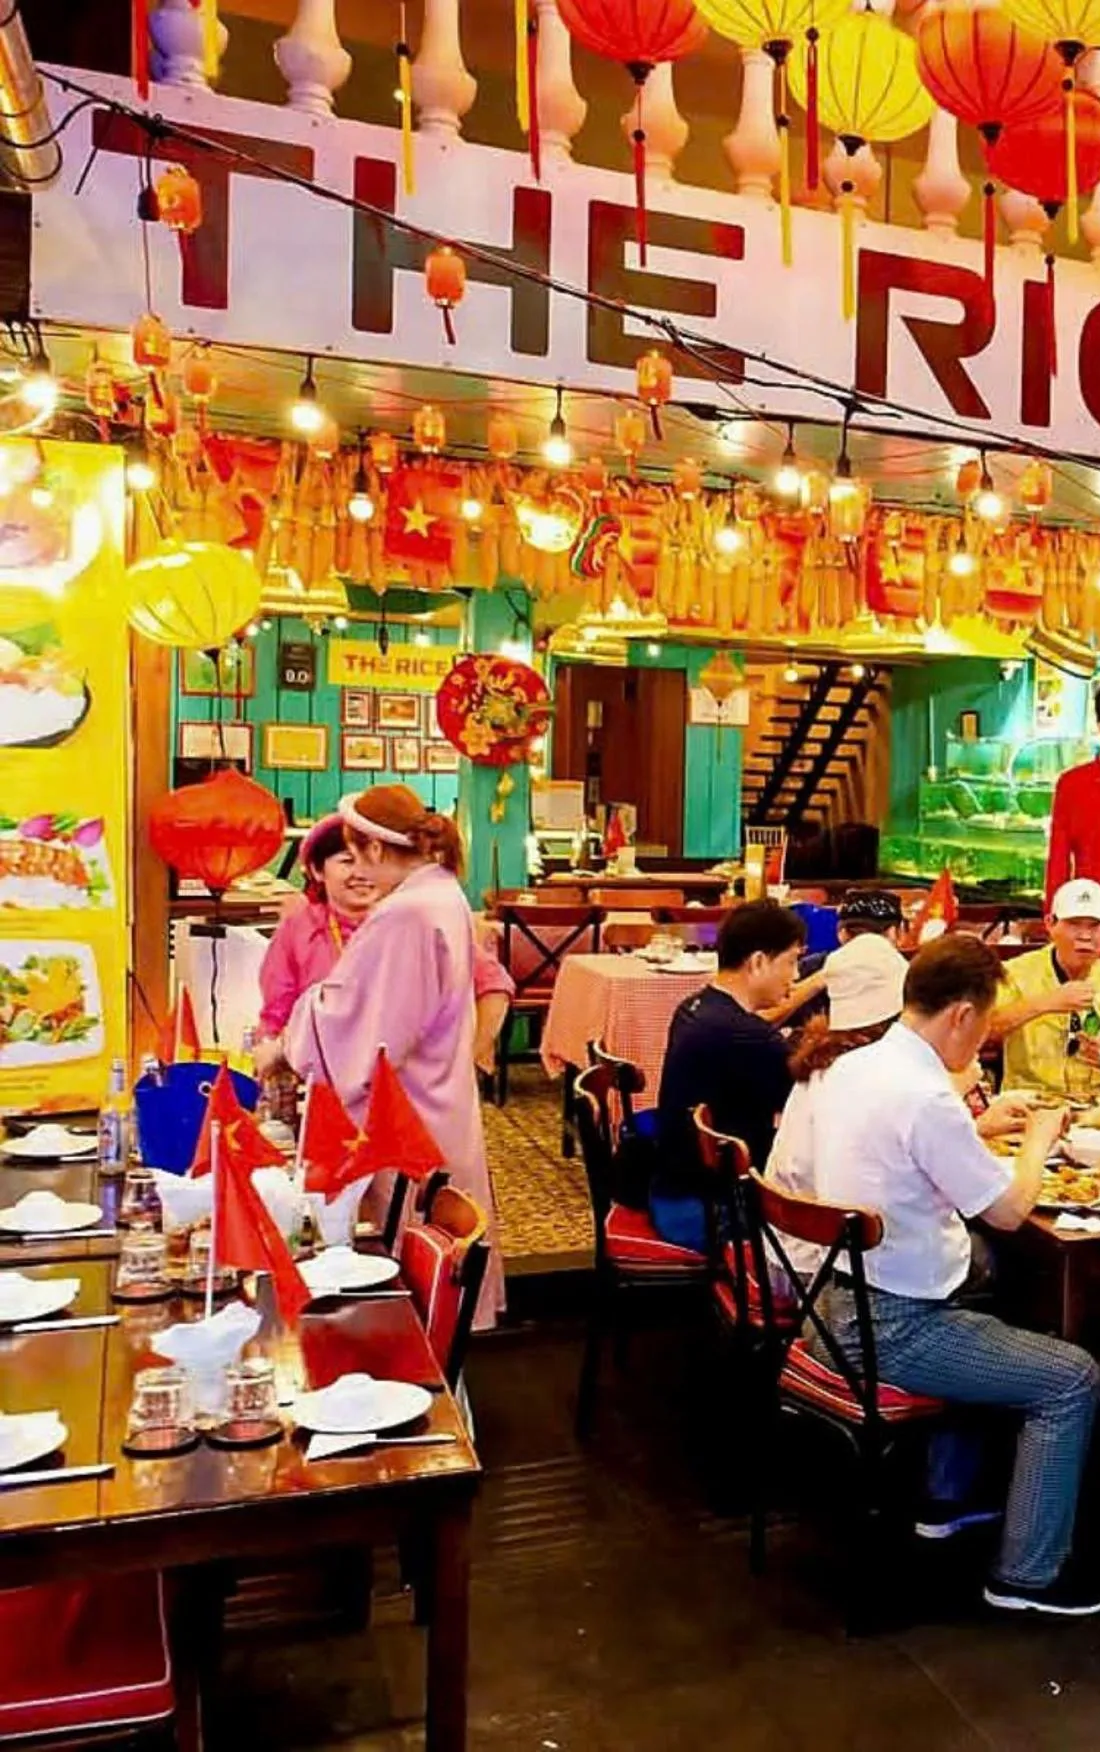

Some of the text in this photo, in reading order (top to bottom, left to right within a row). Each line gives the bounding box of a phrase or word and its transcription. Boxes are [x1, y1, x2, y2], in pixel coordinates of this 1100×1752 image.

[92, 109, 745, 384] THE
[343, 654, 449, 676] THE RICE
